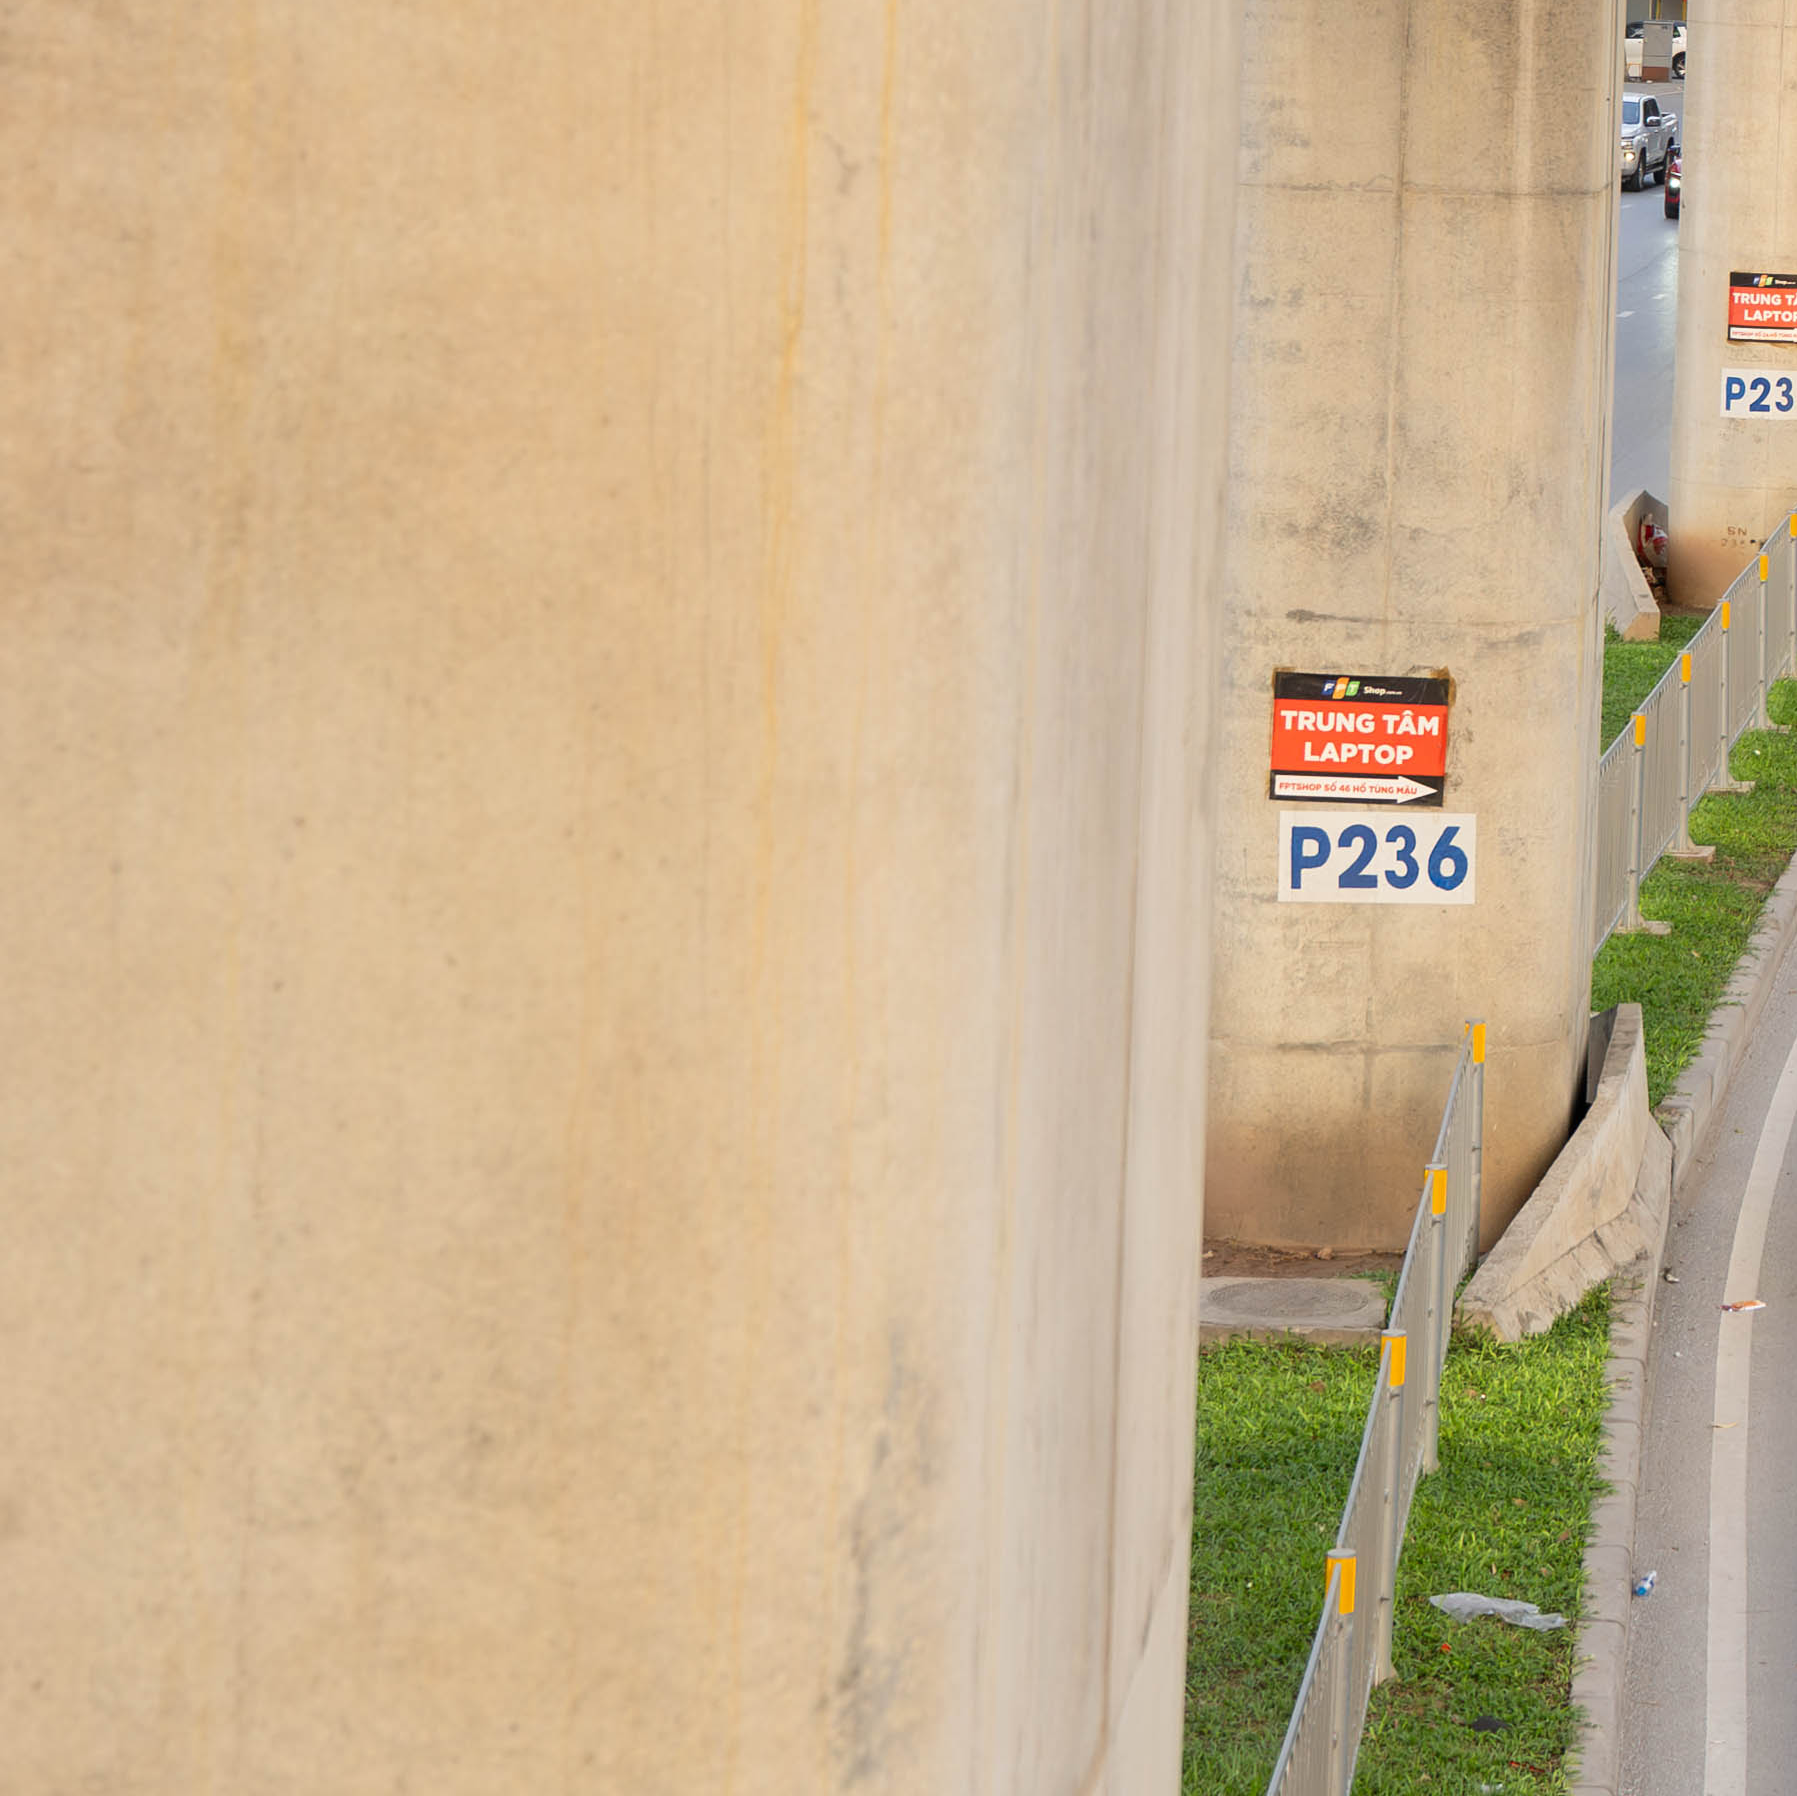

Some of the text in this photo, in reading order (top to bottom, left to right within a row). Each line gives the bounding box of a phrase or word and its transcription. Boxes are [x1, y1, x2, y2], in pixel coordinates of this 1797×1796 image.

[1732, 292, 1782, 306] TRUNG
[1321, 678, 1360, 699] FPT
[1279, 710, 1440, 737] TRUNG TÂM
[1303, 741, 1415, 765] LAPTOP
[1278, 782, 1322, 792] FPTSHOP
[1338, 783, 1351, 793] 46
[1290, 823, 1469, 891] P236
